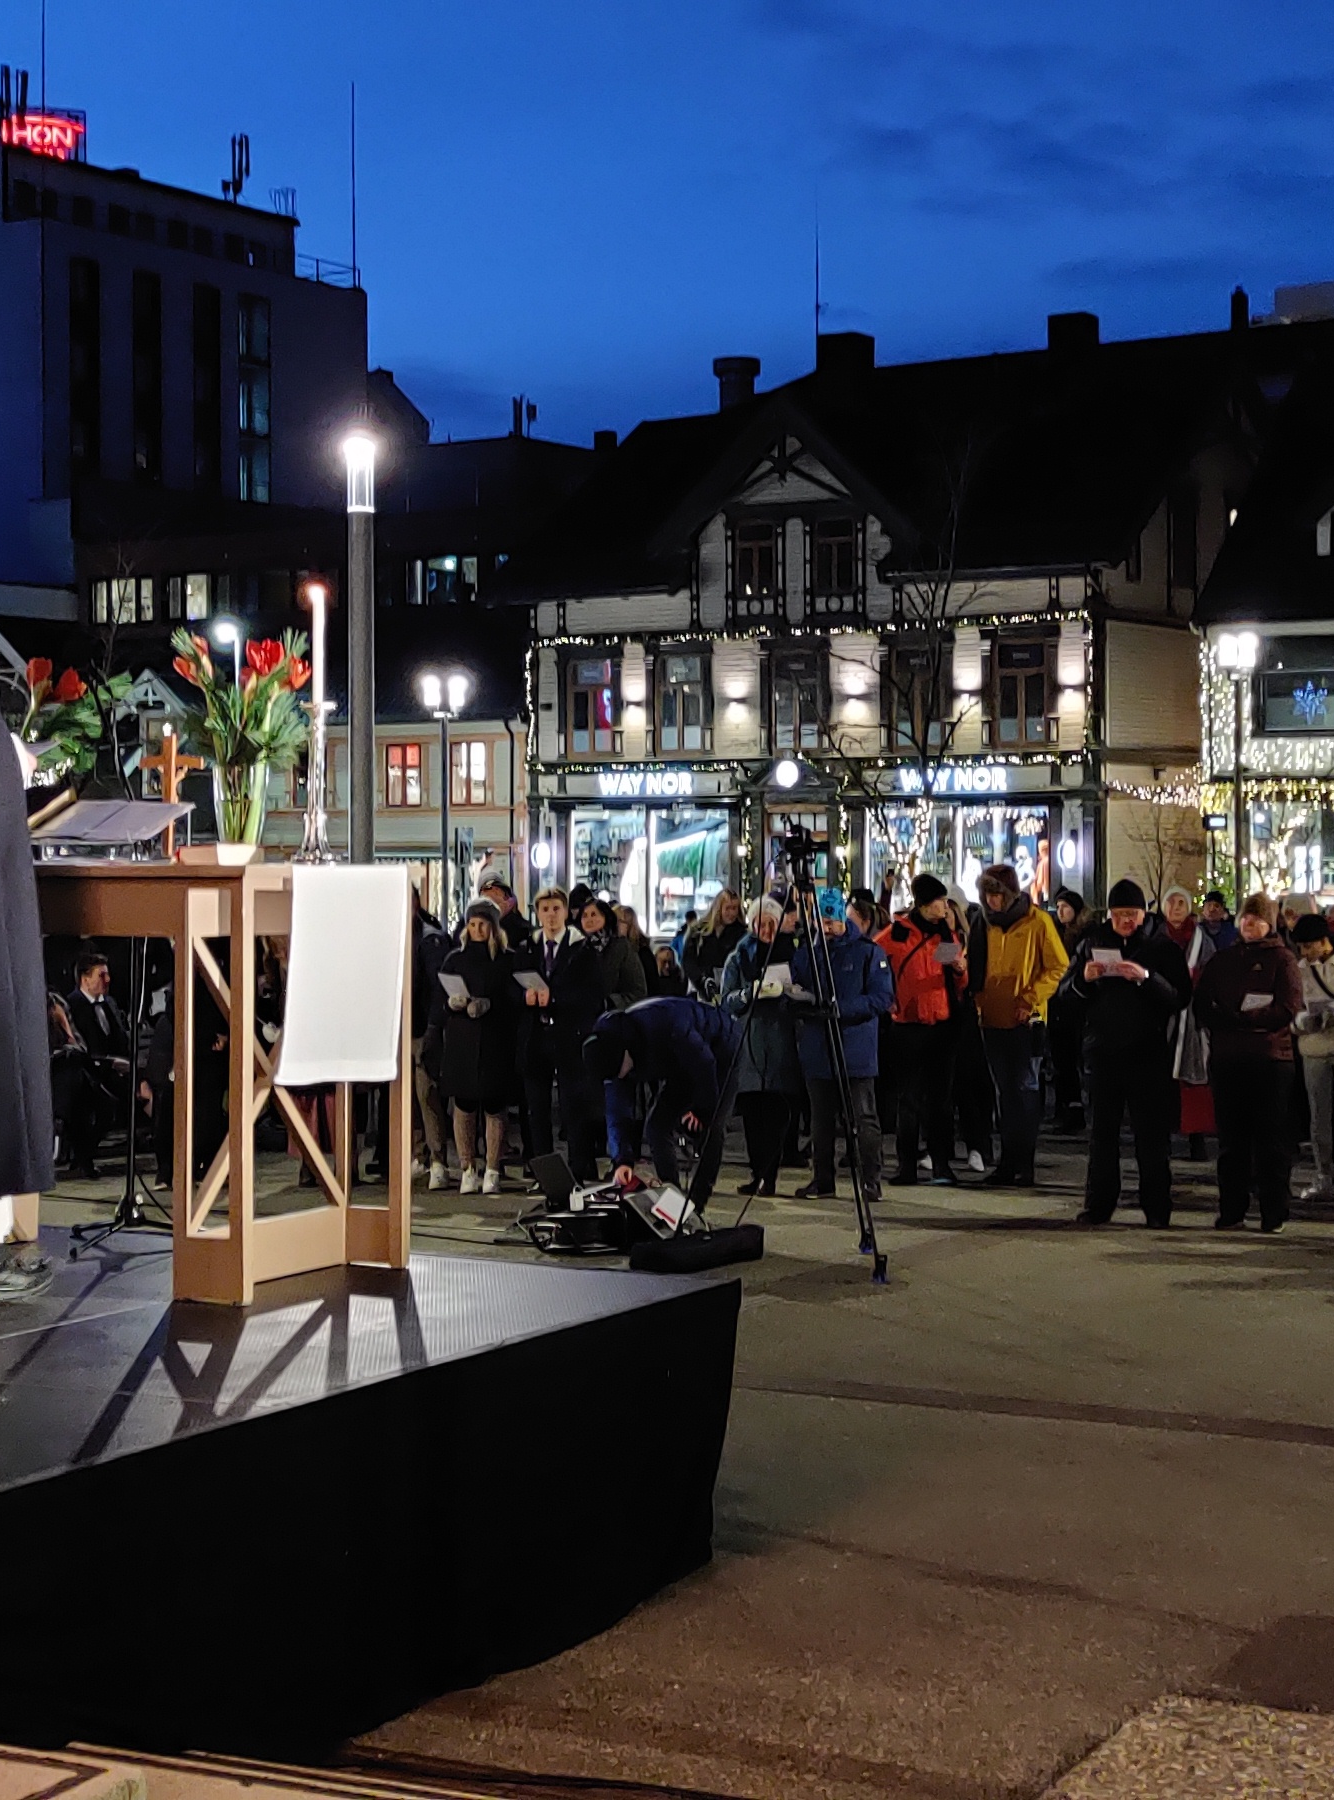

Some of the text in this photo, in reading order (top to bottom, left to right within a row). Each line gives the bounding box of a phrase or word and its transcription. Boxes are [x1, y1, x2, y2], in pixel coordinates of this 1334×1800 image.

[598, 772, 692, 795] WAY NOR
[954, 767, 1007, 791] NOR
